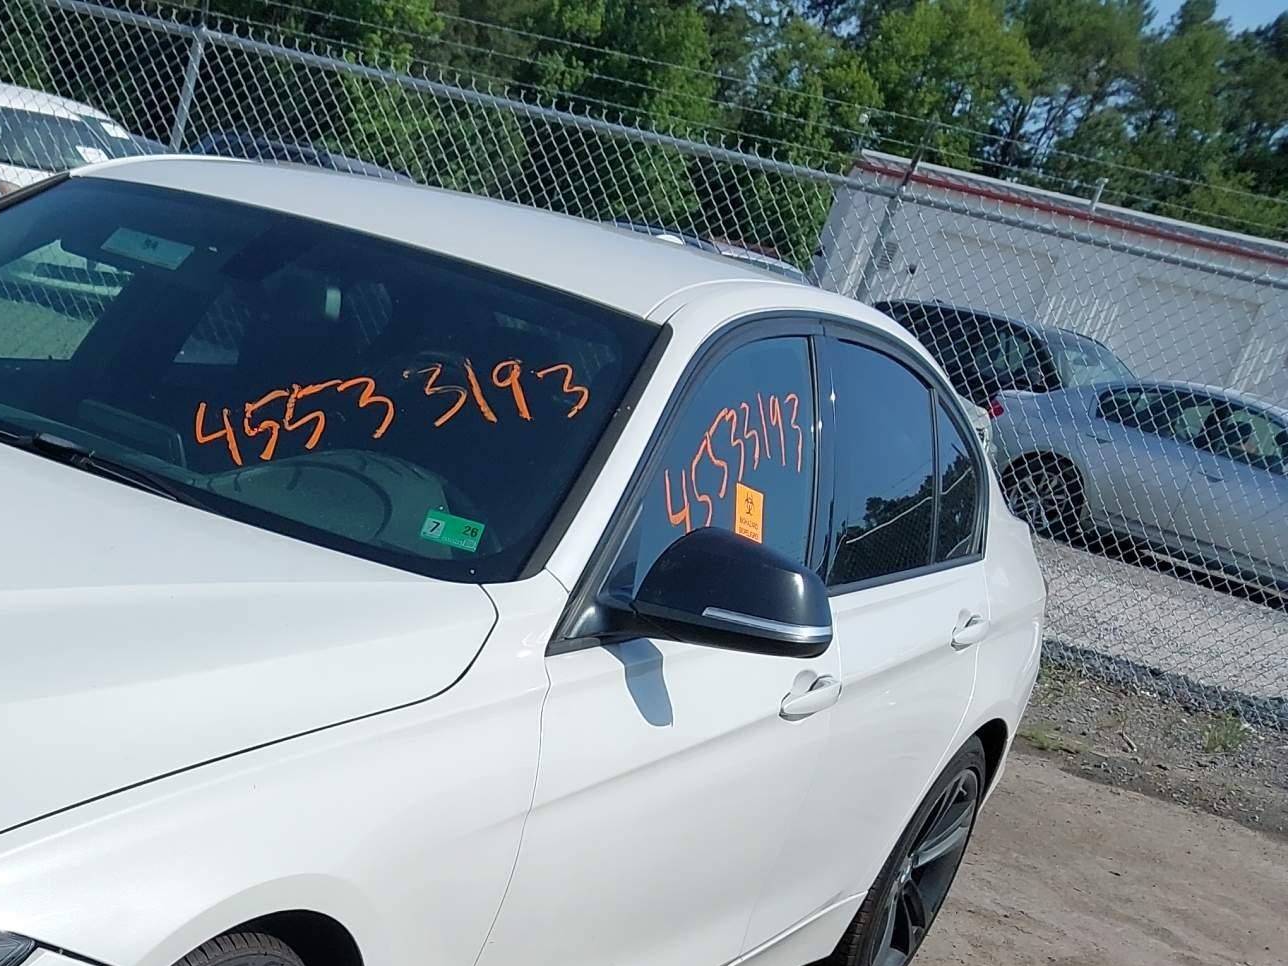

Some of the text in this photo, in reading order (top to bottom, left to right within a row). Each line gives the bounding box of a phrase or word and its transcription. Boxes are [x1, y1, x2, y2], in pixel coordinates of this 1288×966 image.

[664, 392, 803, 535] 45533193
[429, 521, 479, 537] 7 26
